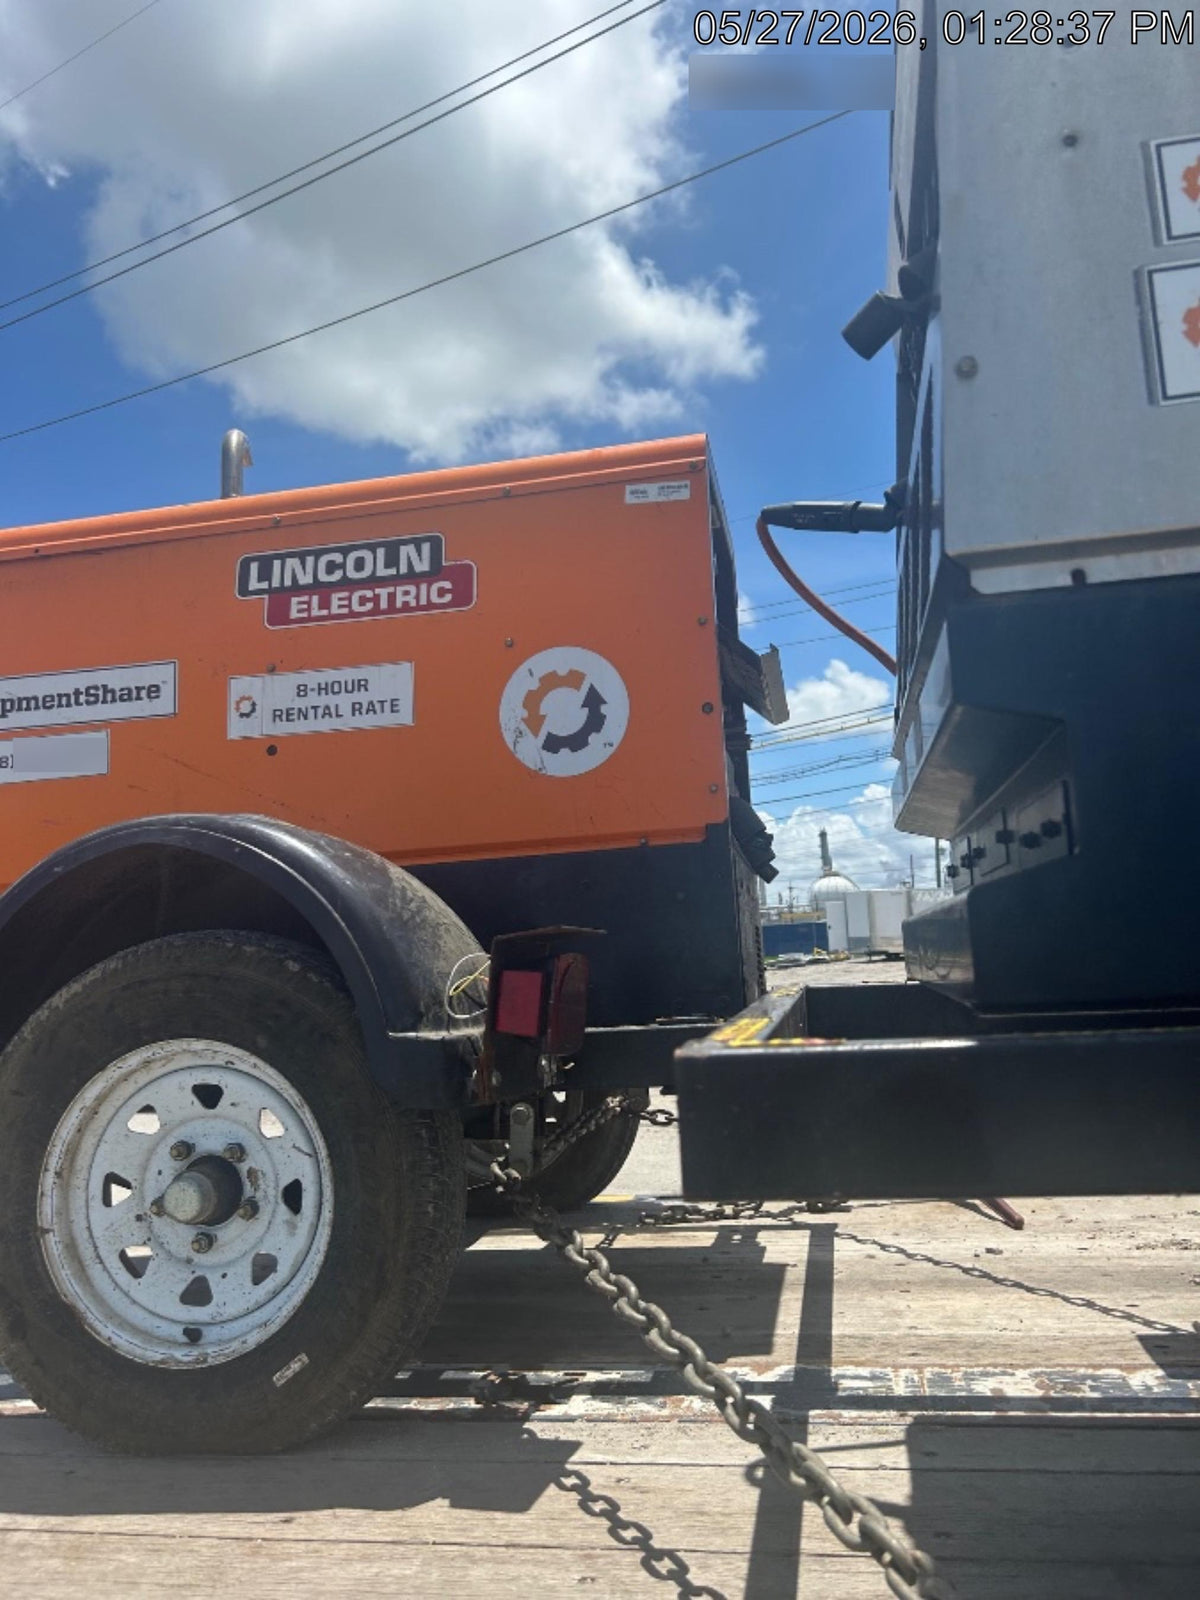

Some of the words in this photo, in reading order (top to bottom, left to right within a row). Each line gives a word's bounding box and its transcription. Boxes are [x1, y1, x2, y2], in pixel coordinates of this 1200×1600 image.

[248, 542, 432, 591] LINCOLN
[289, 580, 453, 620] ELECTRIC
[296, 678, 370, 697] 8-HOUR
[272, 704, 344, 723] RENTAL
[351, 699, 401, 717] RATE
